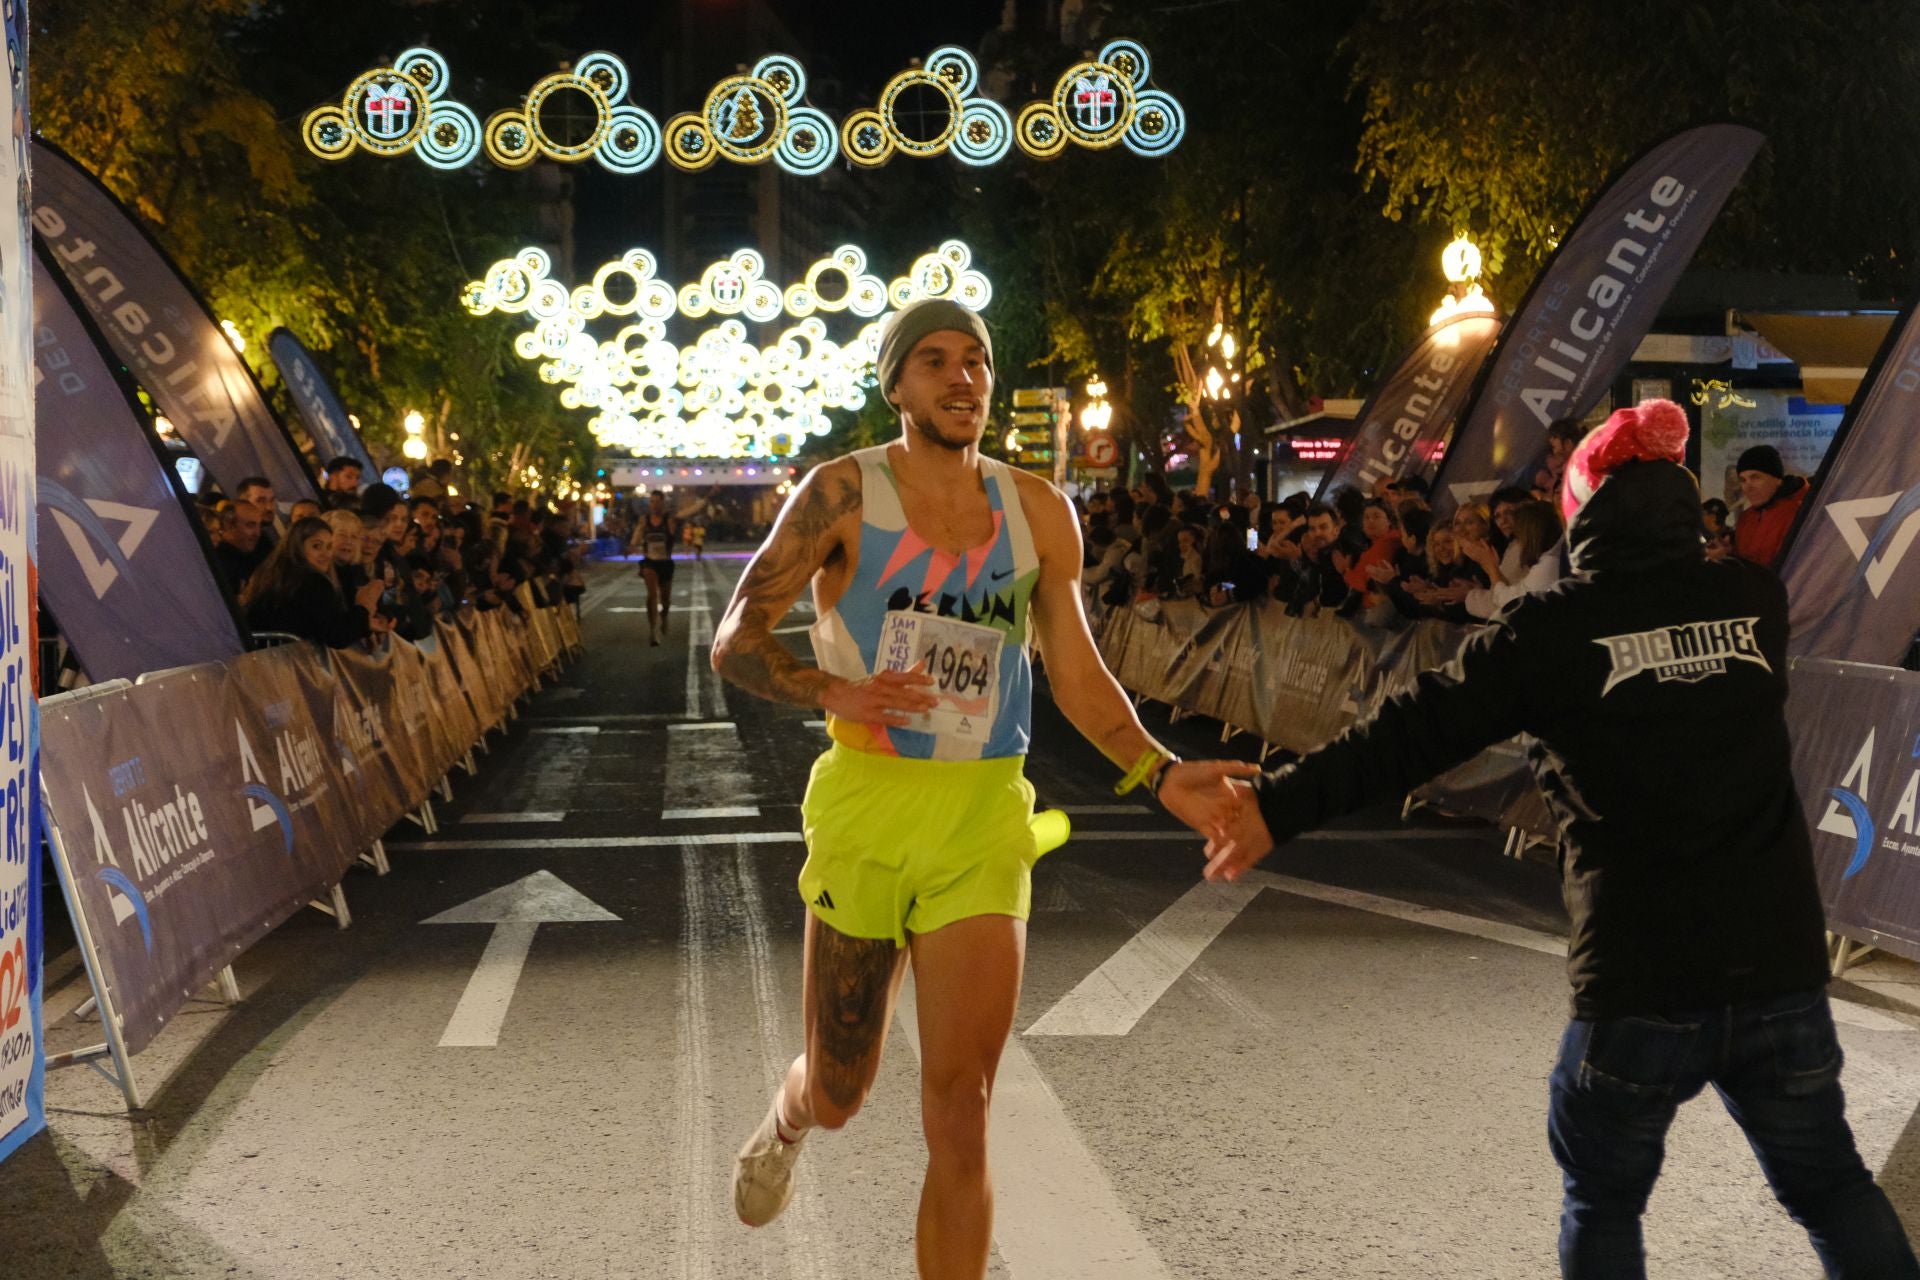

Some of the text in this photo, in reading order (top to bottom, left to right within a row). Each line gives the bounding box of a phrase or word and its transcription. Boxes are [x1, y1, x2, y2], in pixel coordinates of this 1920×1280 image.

[1520, 175, 1685, 429] Alicante
[1610, 293, 1632, 328] Alicante
[1359, 350, 1456, 492] licante
[888, 586, 1016, 626] BERLIN
[890, 615, 916, 631] SAN
[889, 645, 911, 661] VES
[924, 642, 989, 696] 1964
[1661, 659, 1720, 678] SPEAKER
[122, 784, 208, 882] Alicante
